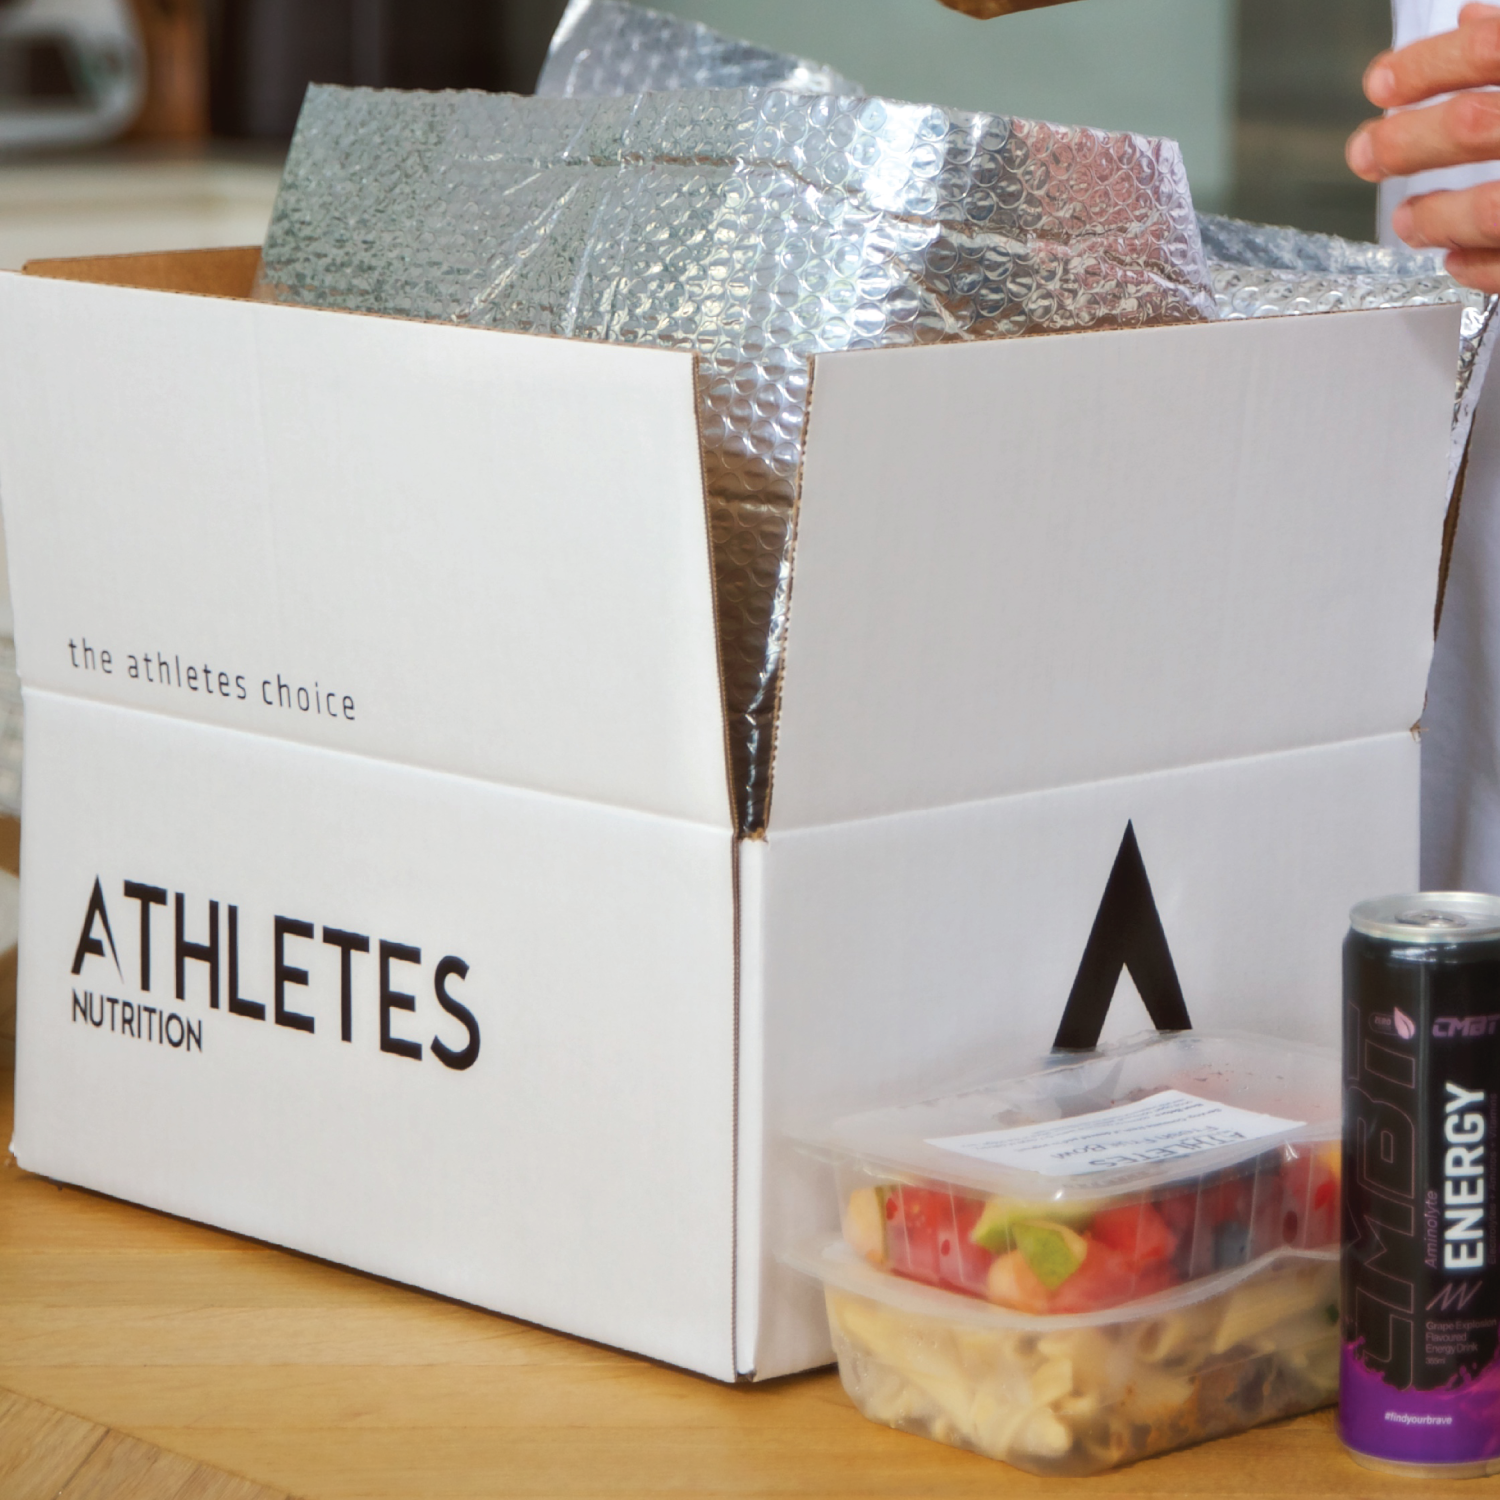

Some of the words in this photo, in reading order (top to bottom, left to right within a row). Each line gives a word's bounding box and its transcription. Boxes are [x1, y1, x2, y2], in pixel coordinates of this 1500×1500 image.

[67, 637, 114, 674] the
[126, 651, 247, 701] athletes
[261, 674, 357, 721] choice
[70, 873, 481, 1072] ATHLETES
[71, 988, 203, 1054] NUTRITION
[1432, 1013, 1500, 1037] CMBT
[1444, 1081, 1485, 1269] ENERGY
[1425, 1321, 1455, 1331] Grape
[1456, 1319, 1497, 1330] Explosion
[1425, 1332, 1467, 1342] Flavoured
[1425, 1344, 1455, 1355] Energy
[1456, 1343, 1478, 1353] Drink
[1384, 1411, 1453, 1425] #findyourbrave
